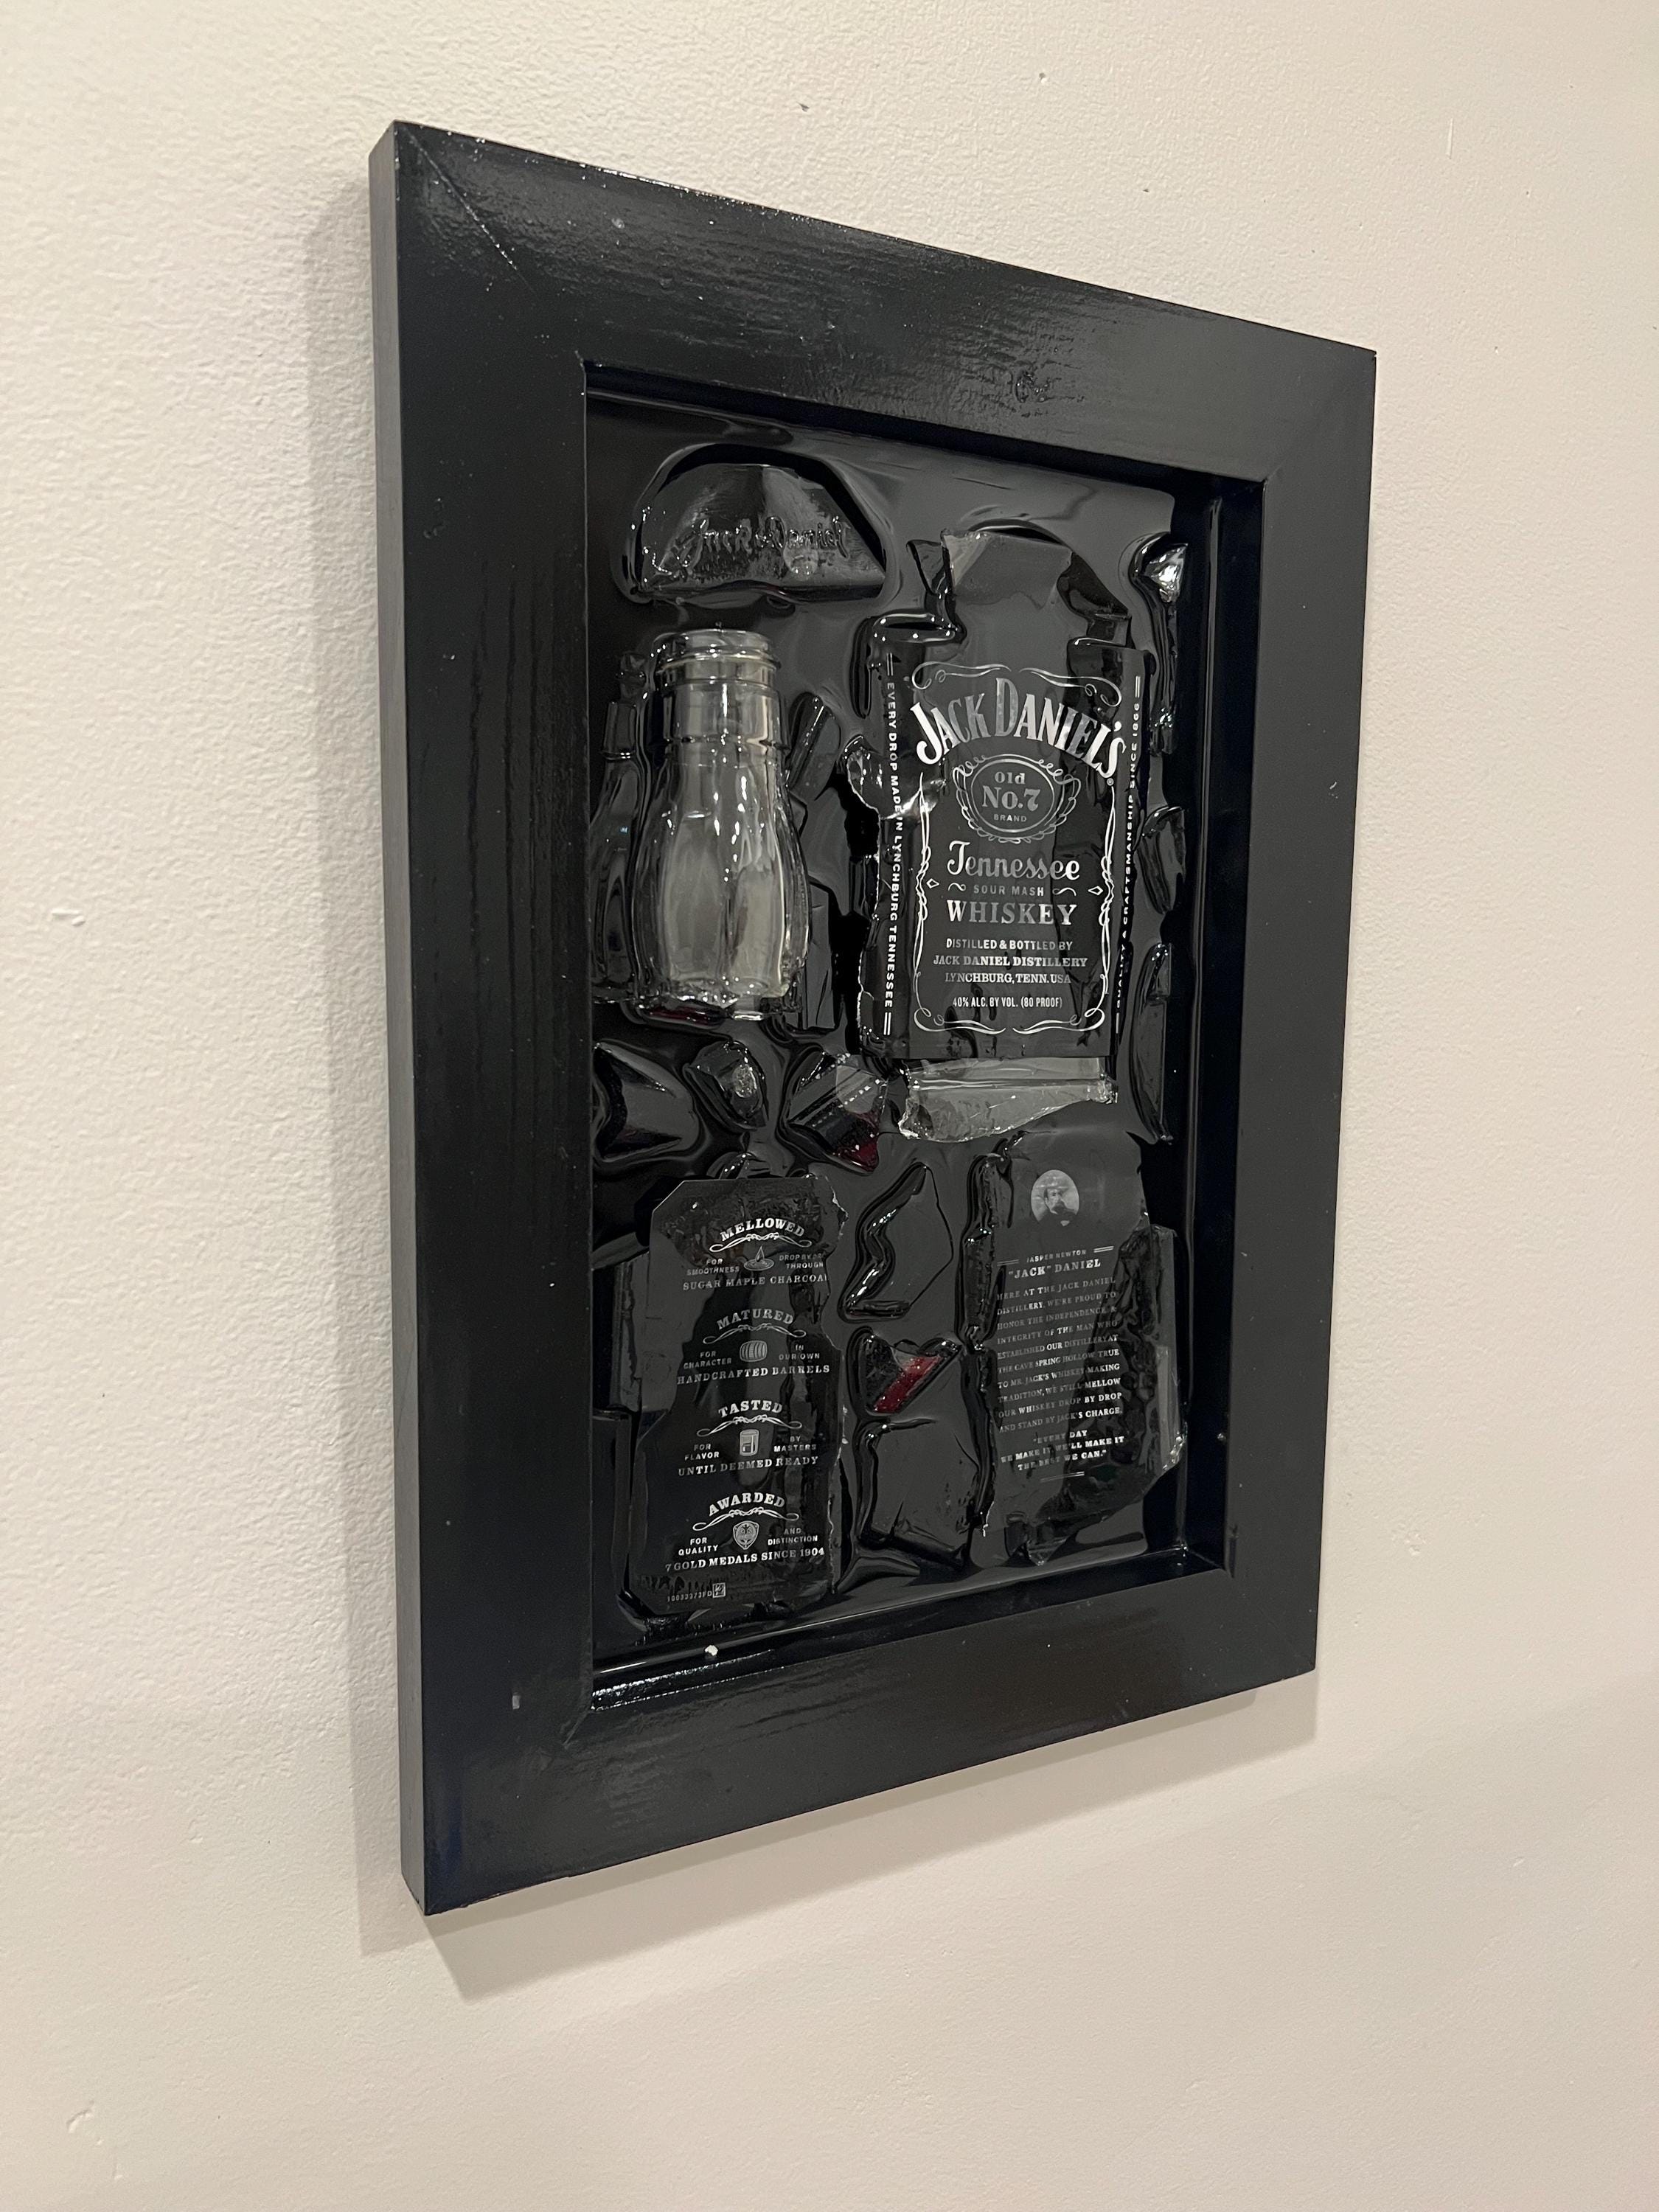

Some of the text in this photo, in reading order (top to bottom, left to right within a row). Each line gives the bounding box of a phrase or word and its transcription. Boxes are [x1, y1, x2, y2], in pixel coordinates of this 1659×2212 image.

[909, 678, 1127, 779] JACK DANIEL'S
[995, 771, 1026, 785] Old
[994, 813, 1027, 822] BRAND
[884, 682, 903, 1007] EVERY DROP MADE IN LYNCHBURG TENNESSEE
[947, 840, 1080, 880] Tennessee
[1123, 794, 1133, 925] CRAFTSMANSHIP
[973, 885, 1044, 897] SOUR MASH
[947, 900, 1077, 925] WHISKEY
[946, 938, 1073, 950] DISTILLED & BOTTLED BY
[933, 955, 1088, 967] JACK DANIEL DISTILLERY
[945, 973, 1015, 984] LYNCHBURG,
[953, 997, 1062, 1009] 40% ALC. BY VOL. (80 PROOF)
[720, 1217, 804, 1241] MELLOWED
[686, 1266, 740, 1276] SMOOTHNESS
[1009, 1259, 1101, 1279] "JACK" DANIEL
[683, 1279, 720, 1290] SUGAR
[726, 1276, 765, 1287] MAPLE
[1023, 1287, 1037, 1296] AT
[1037, 1284, 1055, 1295] THE
[1058, 1281, 1079, 1292] JACK
[1082, 1276, 1116, 1287] DANIEL
[717, 1309, 793, 1329] MATURED
[1028, 1316, 1043, 1325] THE
[997, 1331, 1042, 1345] INTEGRITY
[1057, 1326, 1074, 1335] THE
[1046, 1342, 1062, 1351] OUR
[1108, 1334, 1119, 1342] AT
[683, 1358, 732, 1369] CHARACTER
[1035, 1357, 1061, 1368] SPRING
[1098, 1349, 1119, 1357] TRUE
[677, 1365, 830, 1385] HANDCRAFTED BARRELS
[998, 1380, 1009, 1389] TO
[1087, 1363, 1120, 1374] MAKING
[1085, 1377, 1121, 1388] MELLOW
[718, 1399, 783, 1418] TASTED
[998, 1408, 1016, 1419] OUR
[1018, 1401, 1055, 1414] WHISKEY
[1084, 1394, 1096, 1403] BY
[1098, 1392, 1122, 1402] DROP
[999, 1423, 1015, 1433] AND
[1018, 1419, 1043, 1428] STAND
[1057, 1411, 1083, 1424] JACK'S
[1069, 1430, 1088, 1439] DAY
[684, 1451, 720, 1461] FLAVOR
[773, 1444, 817, 1453] MASTERS
[1001, 1455, 1013, 1464] WE
[1015, 1449, 1040, 1461] MAKE
[1085, 1438, 1112, 1447] MAKE
[1114, 1436, 1124, 1444] IT
[678, 1455, 818, 1477] UNTIL DEEMED READY
[708, 1492, 786, 1517] AWARDED
[768, 1535, 818, 1545] DISTINCTION
[665, 1547, 825, 1573] 7 GOLD MEDALS SINCE 1904
[678, 1545, 718, 1556] QUALITY
